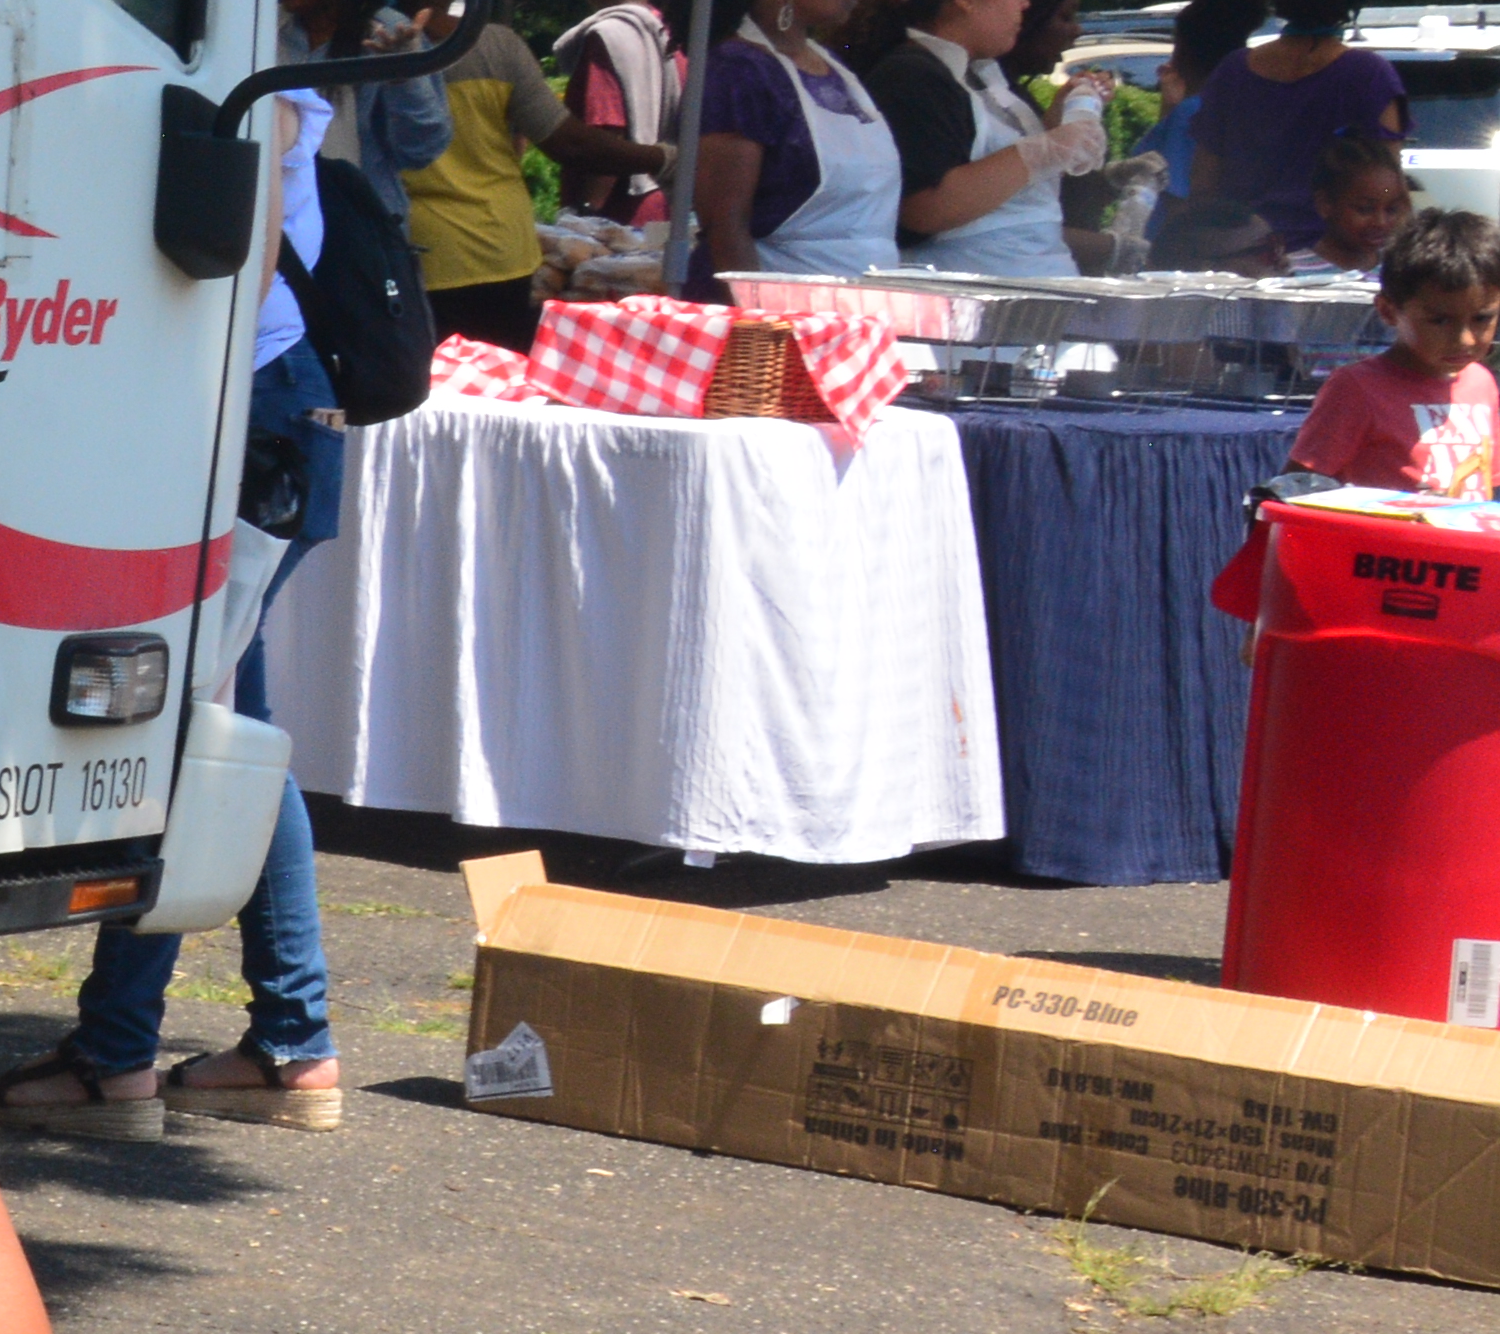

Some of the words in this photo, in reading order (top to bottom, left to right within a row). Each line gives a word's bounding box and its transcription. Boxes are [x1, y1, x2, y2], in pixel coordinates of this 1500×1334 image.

[1352, 552, 1482, 594] BRUTE
[80, 755, 148, 812] 16130
[991, 984, 1140, 1027] PC-330-Blue
[803, 1116, 869, 1148] China
[874, 1128, 897, 1152] in
[902, 1133, 965, 1163] Made
[1277, 1131, 1336, 1158] Meas
[1171, 1174, 1328, 1225] PC-330-Blue
